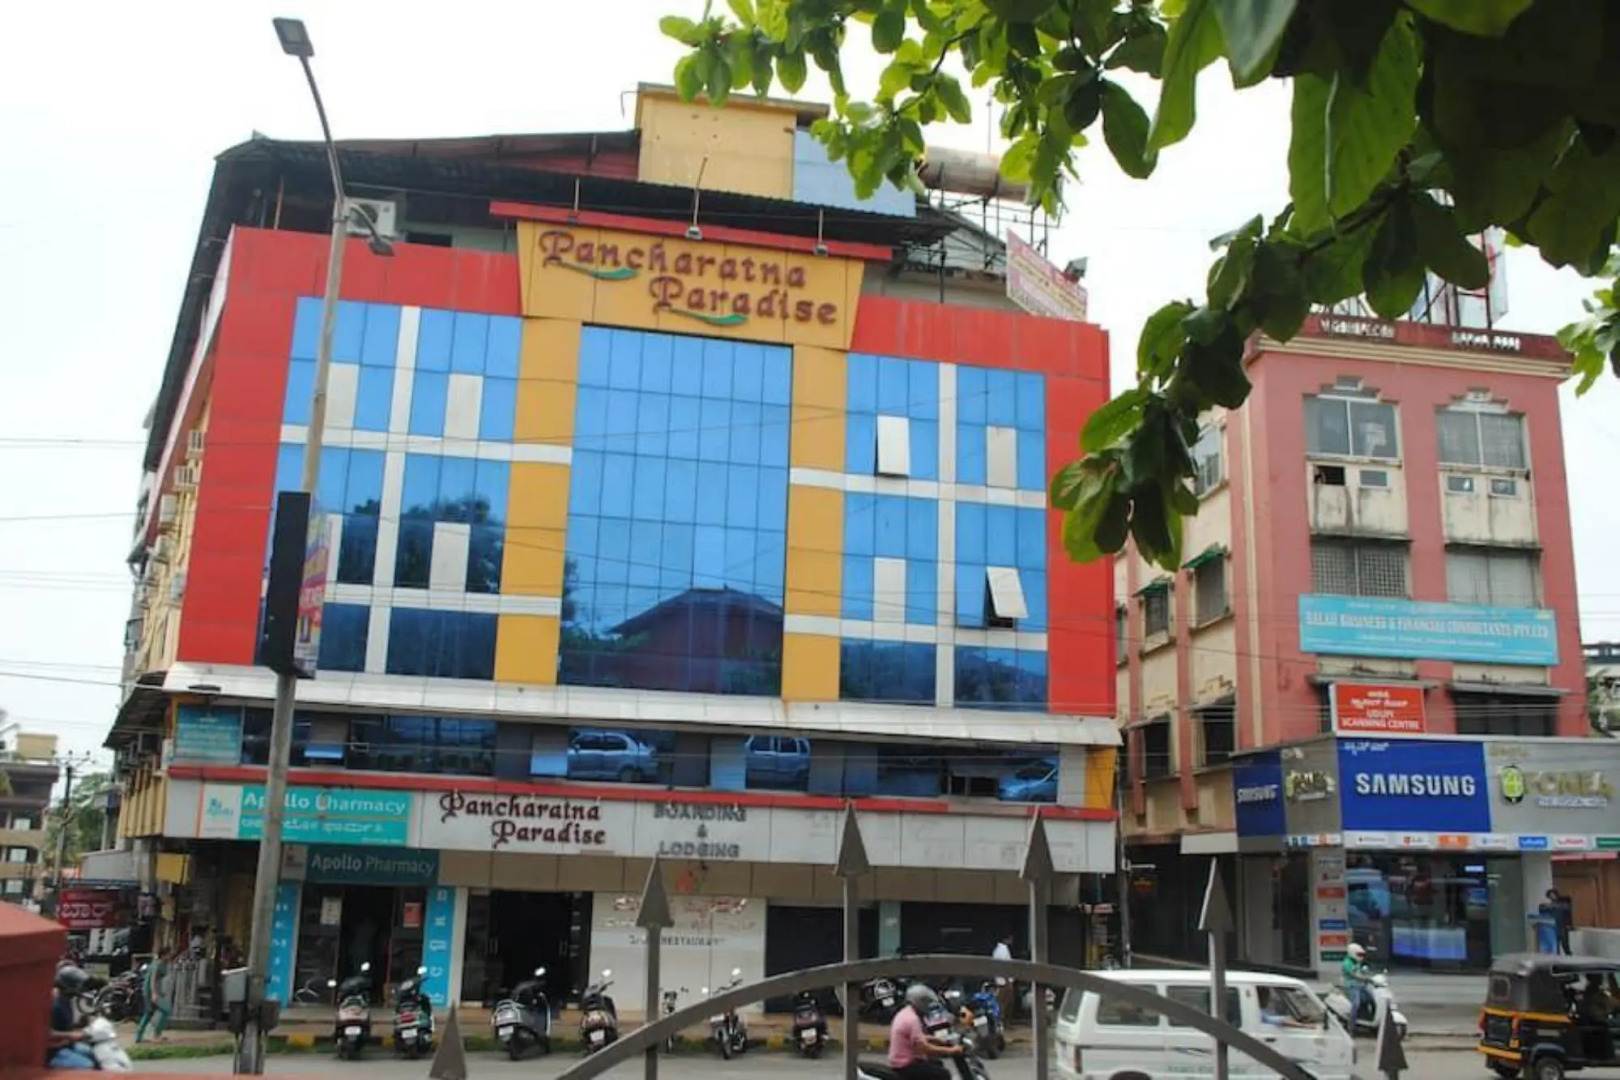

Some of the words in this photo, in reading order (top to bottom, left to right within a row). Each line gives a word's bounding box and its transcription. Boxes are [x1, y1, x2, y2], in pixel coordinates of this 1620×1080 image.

[539, 230, 806, 289] Pancharatna
[649, 276, 838, 325] Paradise
[1355, 772, 1476, 796] SAMSUNG
[439, 792, 600, 823] Pancharatna
[491, 820, 606, 849] Paradise
[658, 841, 740, 859] LODGING
[311, 853, 362, 873] Apollo
[365, 854, 435, 877] Pharmacy
